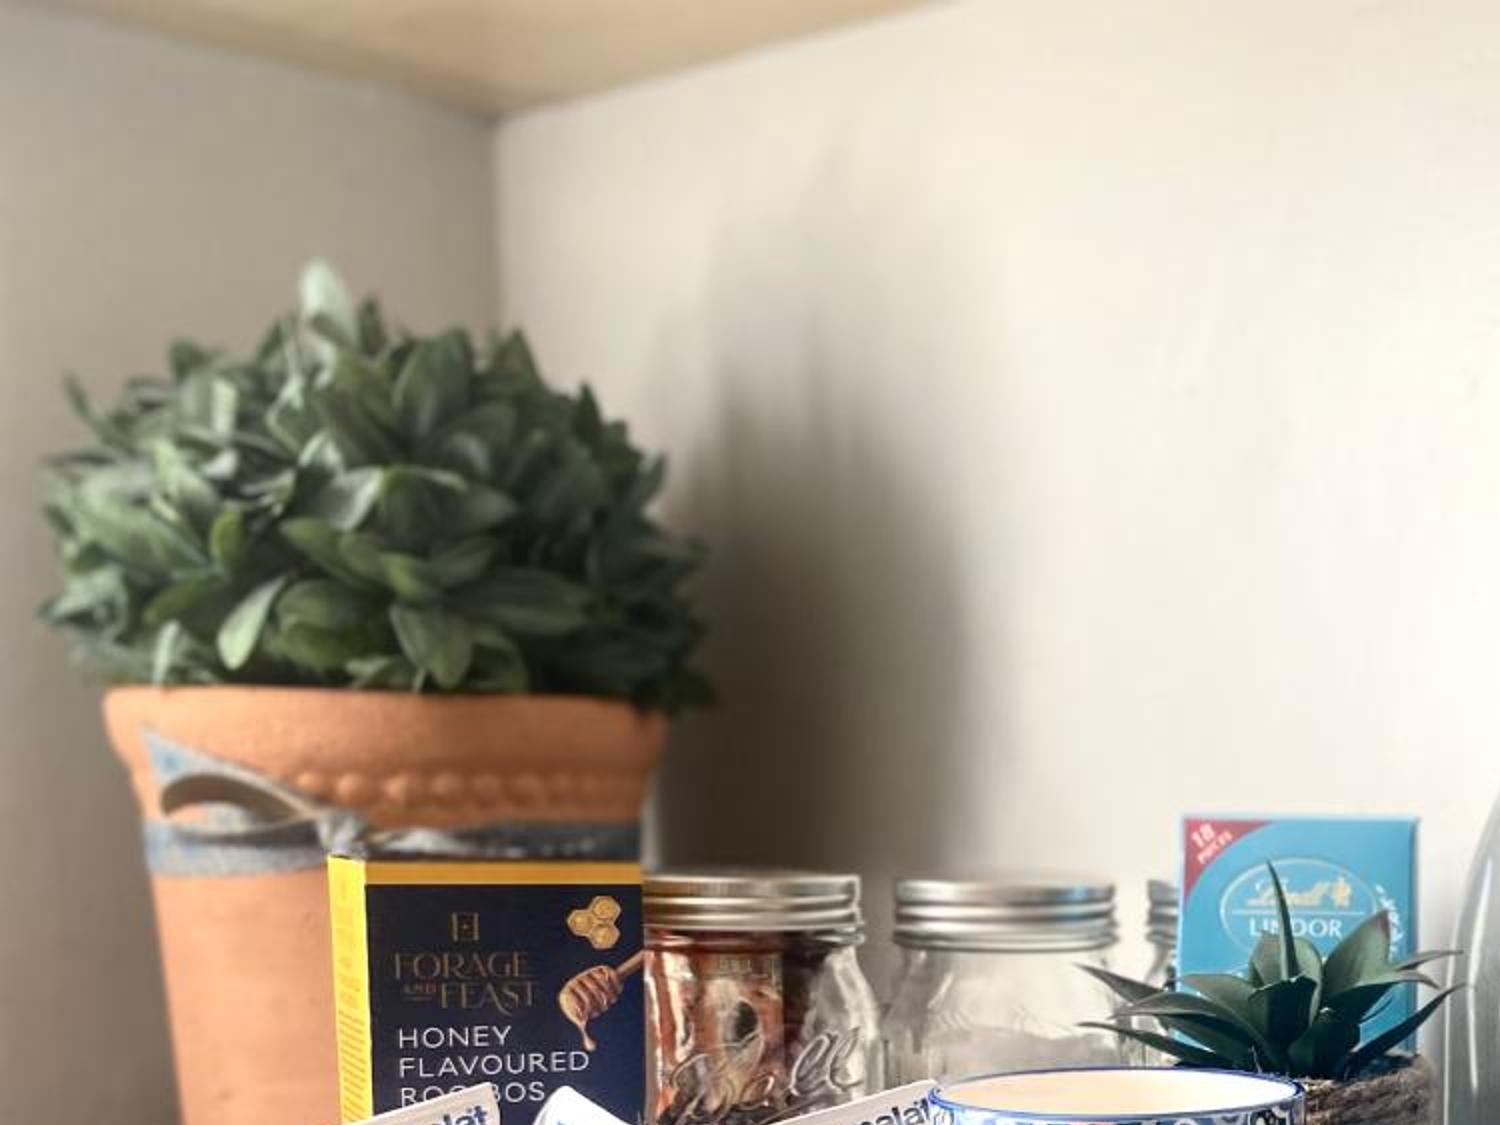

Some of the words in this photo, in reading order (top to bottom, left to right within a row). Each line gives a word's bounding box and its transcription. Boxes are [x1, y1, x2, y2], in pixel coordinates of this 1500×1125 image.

[394, 951, 529, 980] FORAGE
[440, 981, 538, 1016] FEAST
[398, 1025, 512, 1049] HONEY
[399, 1051, 590, 1078] FLAVOURED
